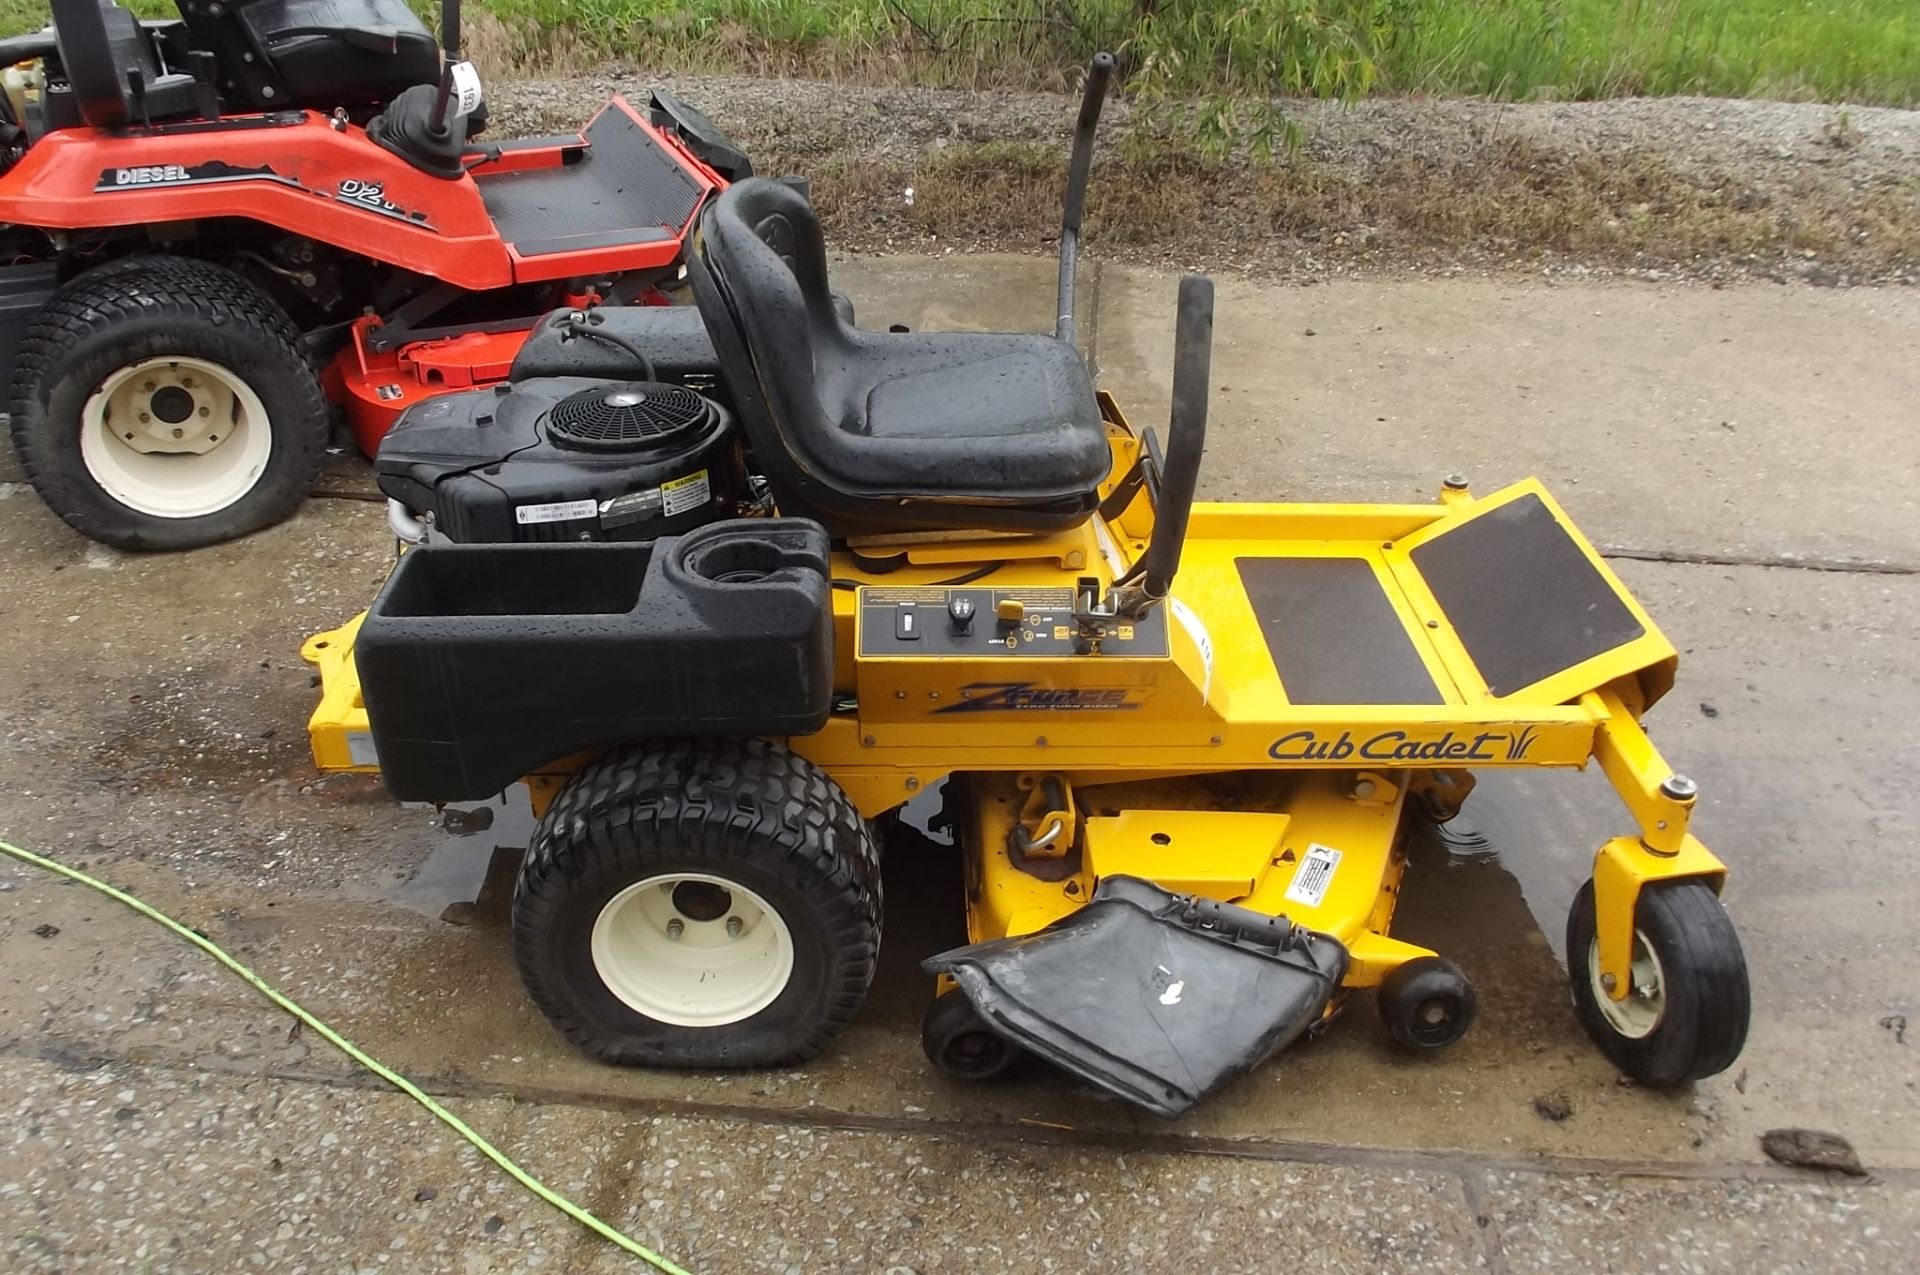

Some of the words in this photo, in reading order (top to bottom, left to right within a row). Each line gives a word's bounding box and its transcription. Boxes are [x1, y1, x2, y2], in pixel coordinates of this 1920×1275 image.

[115, 165, 190, 184] DIESEL
[1268, 731, 1354, 759] Cub
[1358, 731, 1508, 759] Cadet
